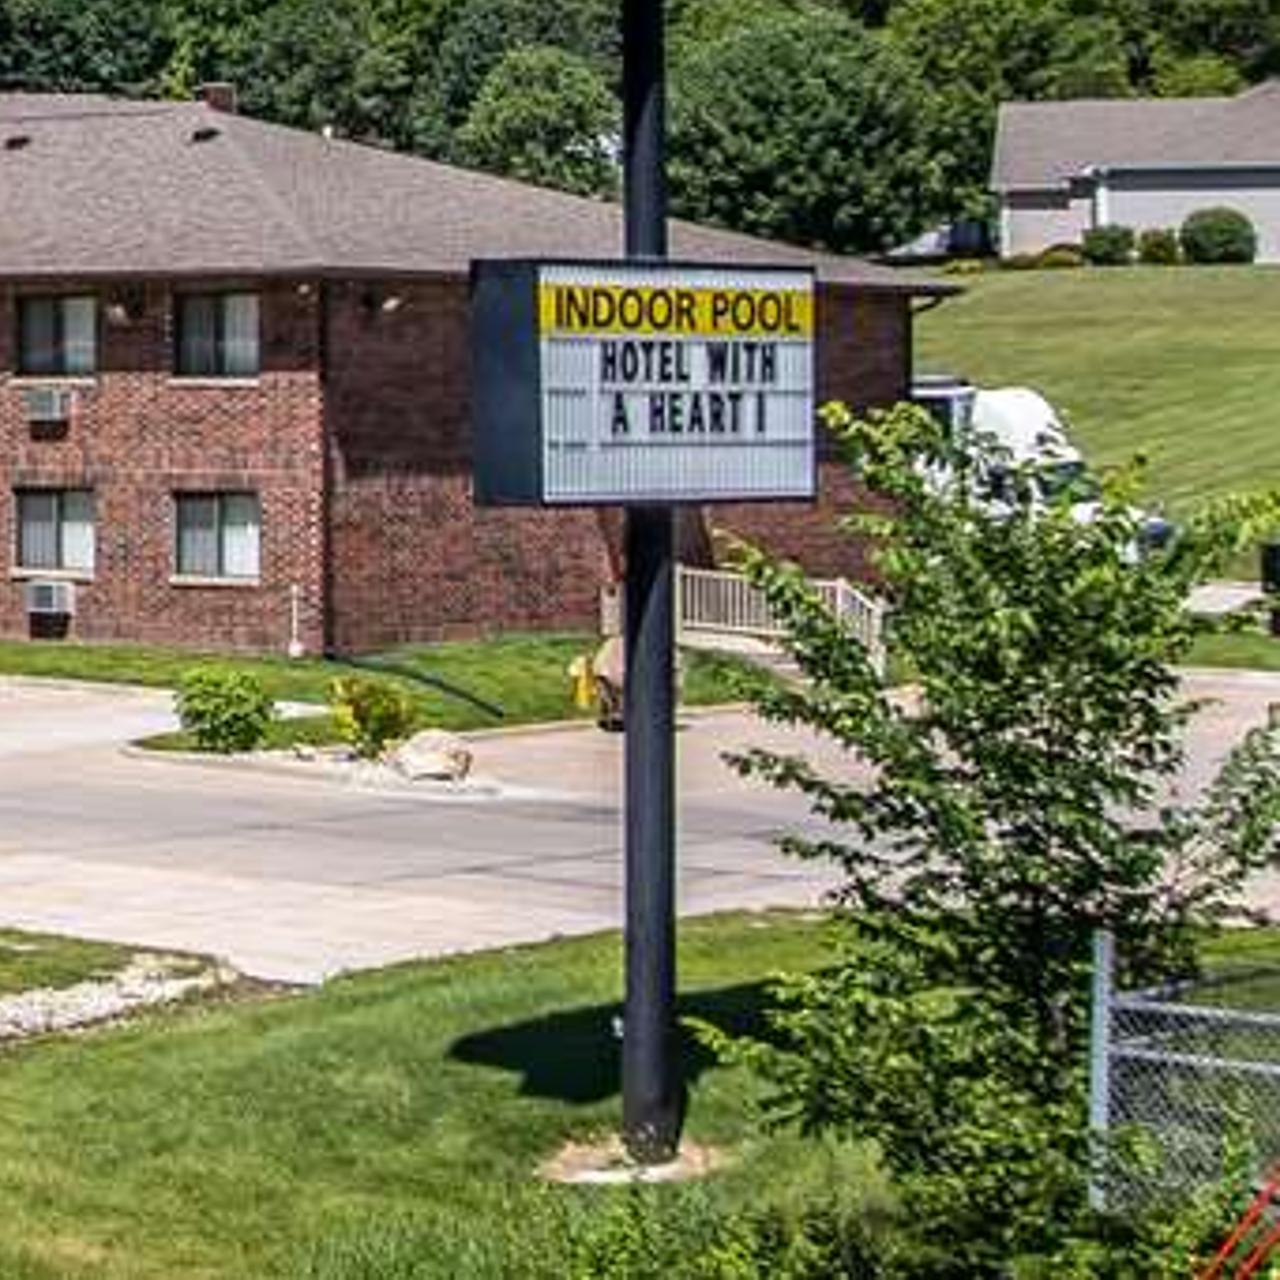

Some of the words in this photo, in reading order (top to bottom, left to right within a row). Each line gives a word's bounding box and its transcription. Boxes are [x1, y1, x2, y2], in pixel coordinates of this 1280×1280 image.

[555, 287, 696, 331] INDOOR
[712, 291, 800, 332] POOL
[601, 341, 690, 382] HOTEL
[707, 341, 776, 382] WITH
[612, 392, 628, 432] A
[649, 392, 742, 433] HEART
